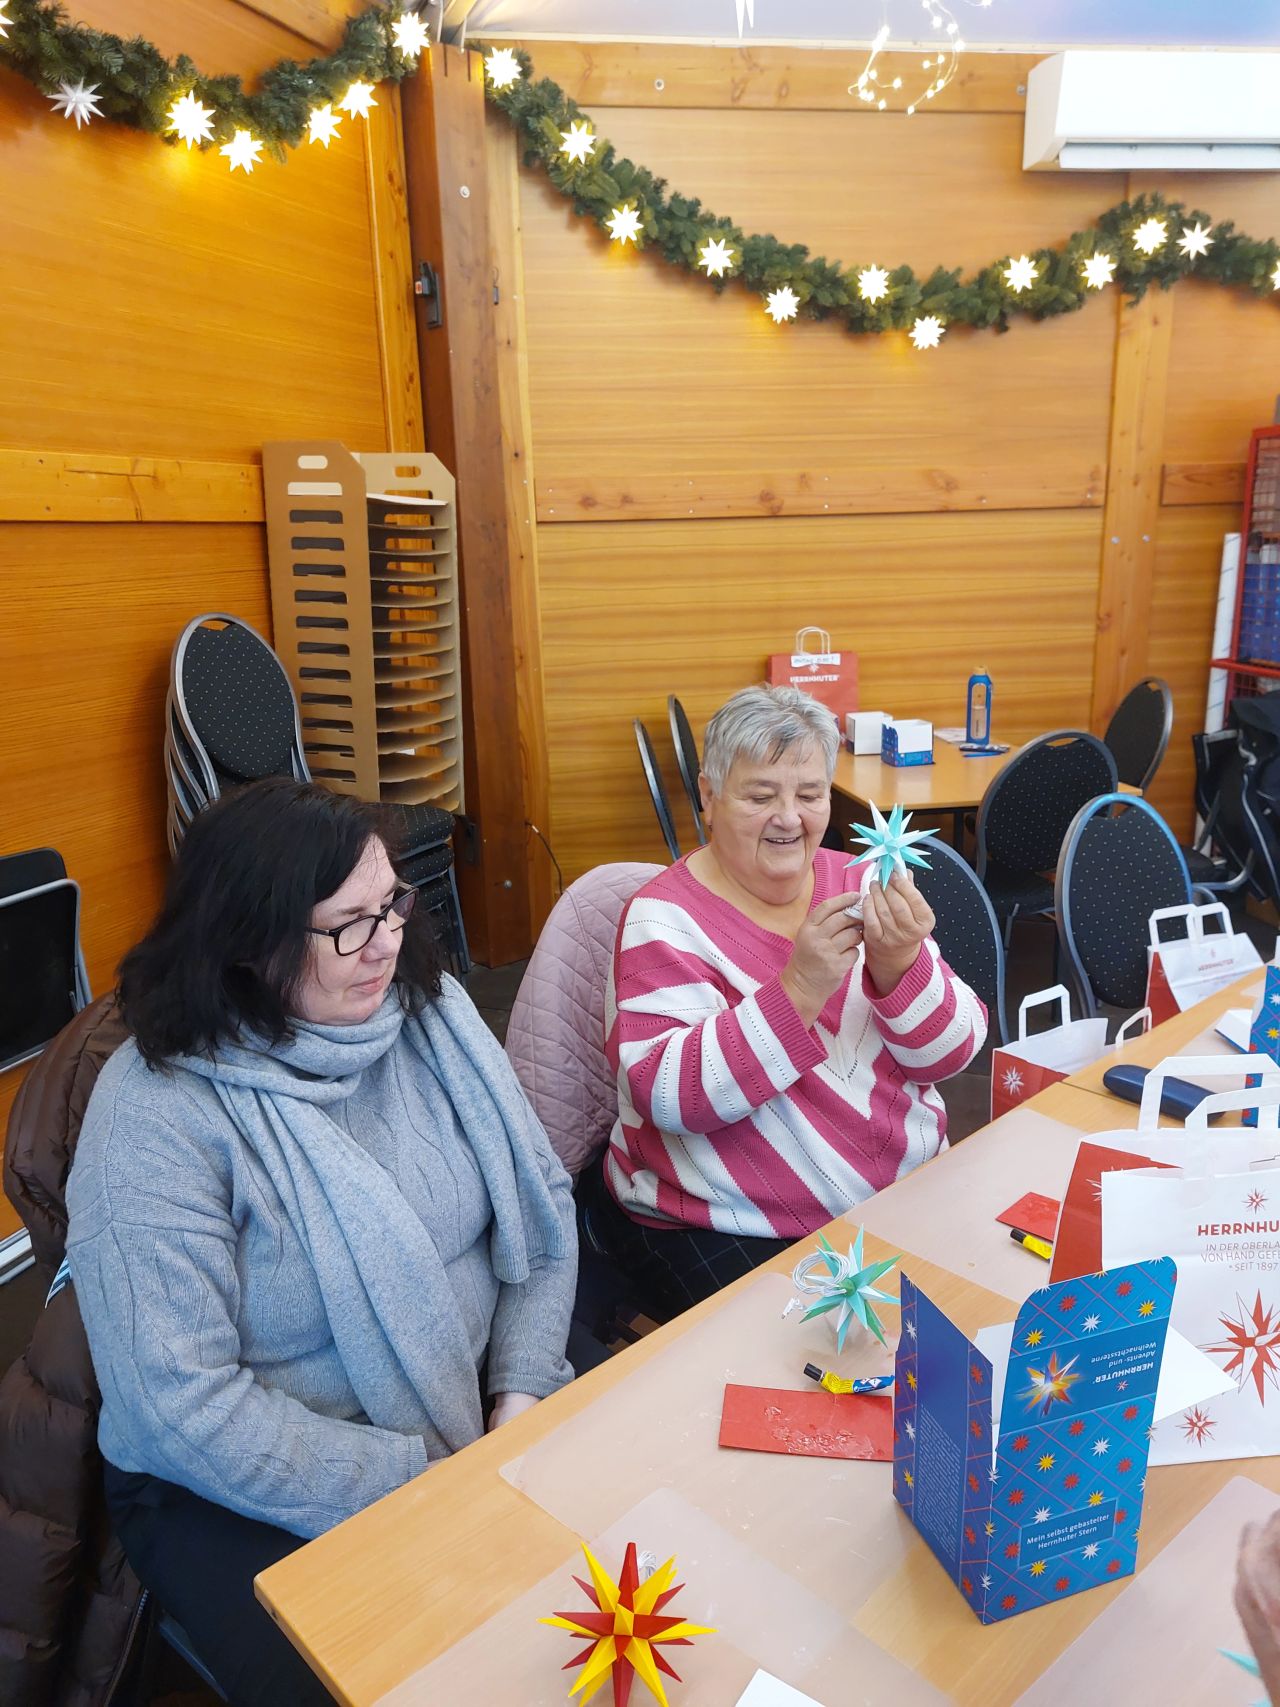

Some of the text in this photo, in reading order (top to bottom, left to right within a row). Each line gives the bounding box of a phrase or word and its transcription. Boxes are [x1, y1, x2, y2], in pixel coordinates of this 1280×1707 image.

[1206, 1243, 1217, 1252] IN
[1219, 1242, 1239, 1252] DER
[1200, 1251, 1224, 1263] VON
[1226, 1250, 1255, 1262] HAND
[1234, 1261, 1279, 1272] SEIT 1897
[1091, 1341, 1157, 1364] Weihnachtssterne
[1108, 1358, 1123, 1369] und
[1026, 1514, 1110, 1545] Mein selbst gebastelter
[1038, 1526, 1097, 1550] Herrnhuter Stern
